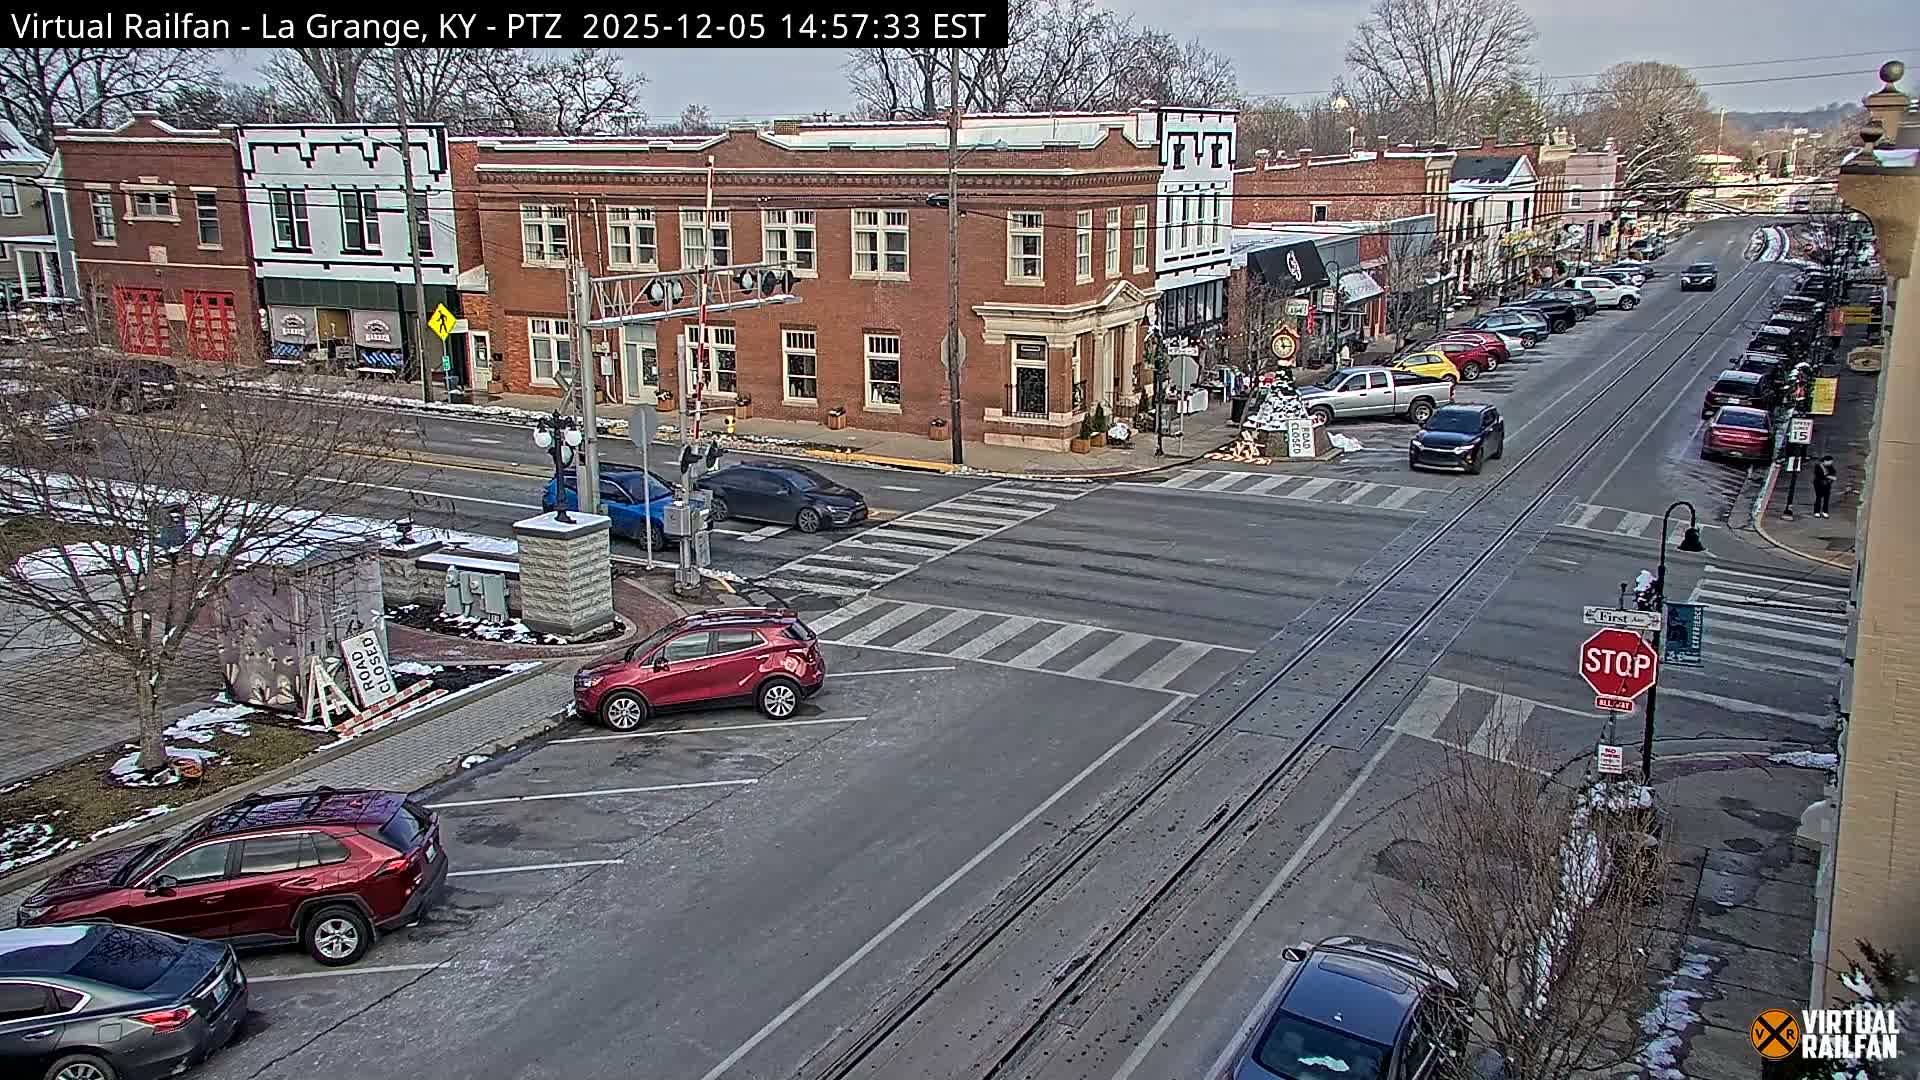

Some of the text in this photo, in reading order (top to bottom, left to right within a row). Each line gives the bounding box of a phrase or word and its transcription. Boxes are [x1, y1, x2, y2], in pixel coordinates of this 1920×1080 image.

[1291, 423, 1301, 454] CLOSED
[1301, 427, 1311, 449] ROAD
[1793, 431, 1808, 441] 15
[1599, 611, 1627, 623] First
[351, 650, 374, 692] ROAD
[363, 636, 390, 695] CLOSED
[1585, 647, 1651, 679] STOP
[1598, 698, 1613, 707] ALL
